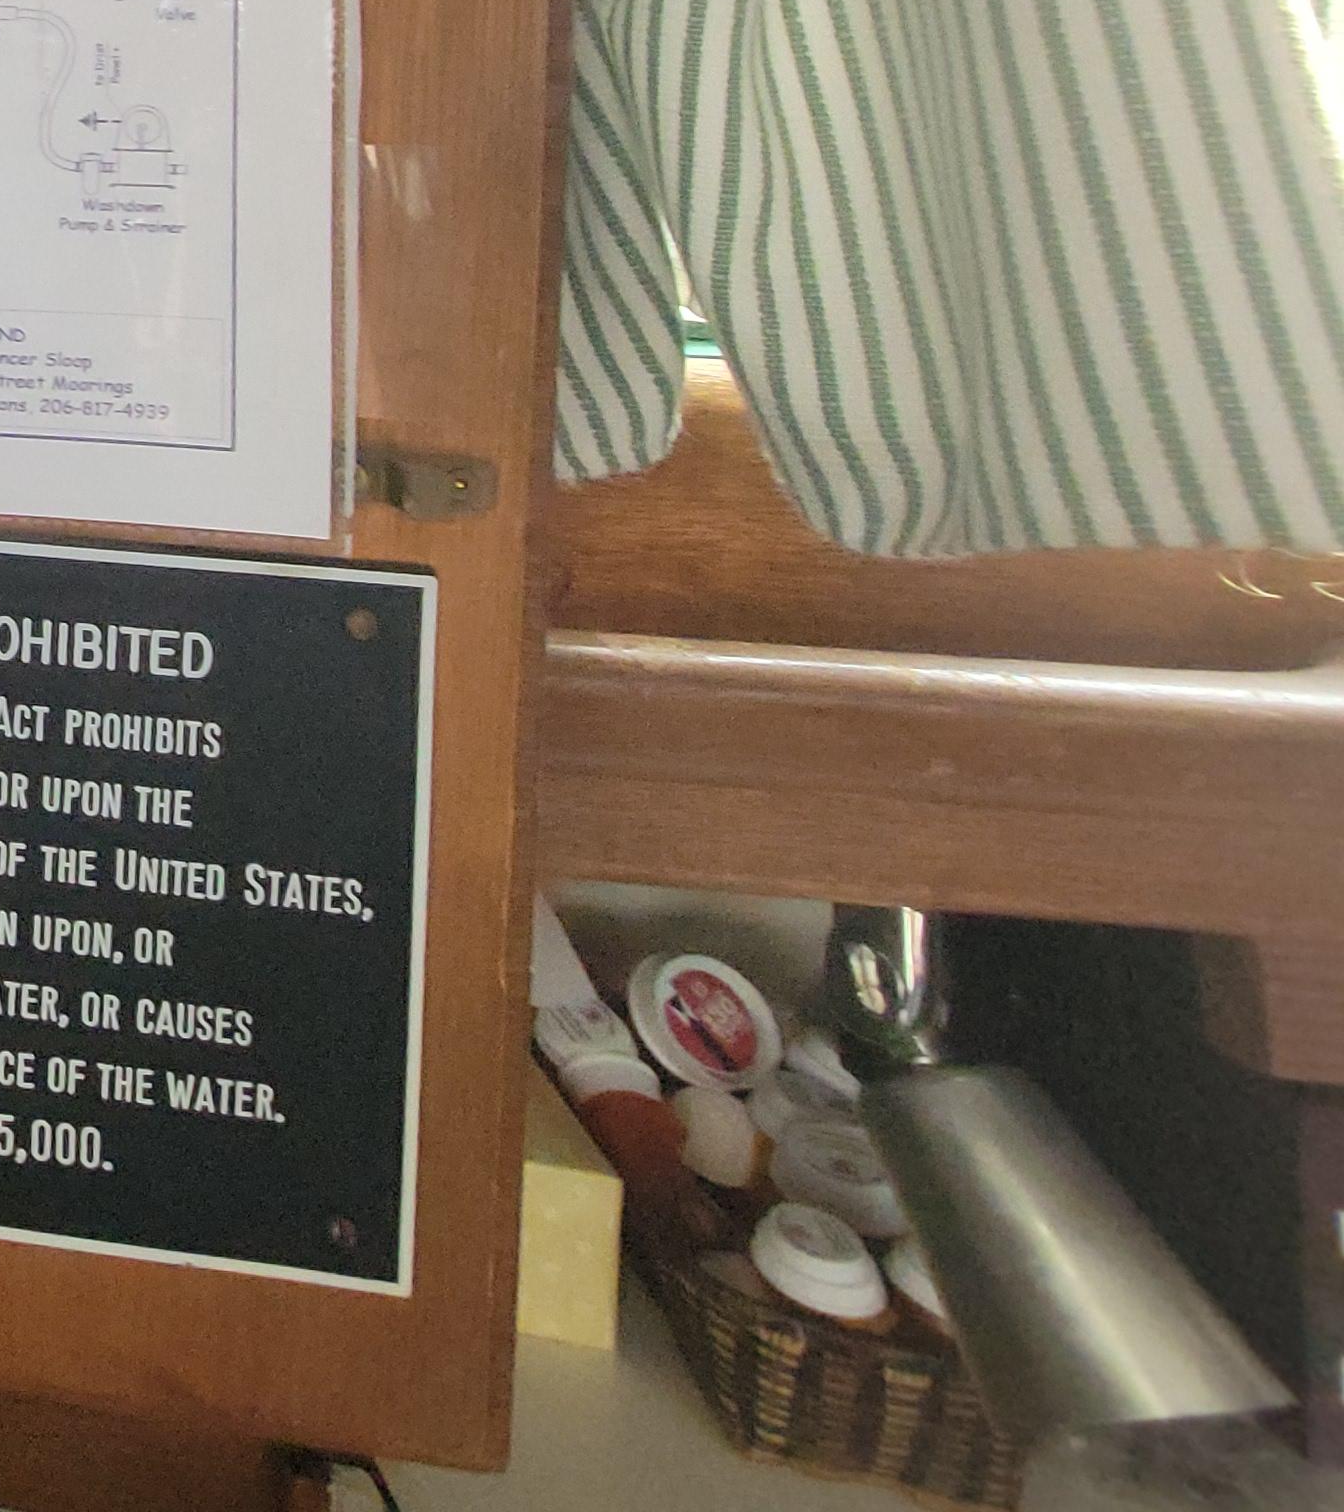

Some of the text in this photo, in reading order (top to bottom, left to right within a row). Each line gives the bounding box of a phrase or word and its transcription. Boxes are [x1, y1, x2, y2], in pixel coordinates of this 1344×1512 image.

[45, 352, 92, 372] Sloop
[51, 375, 133, 398] Moorings
[64, 708, 222, 758] PROHIBITS
